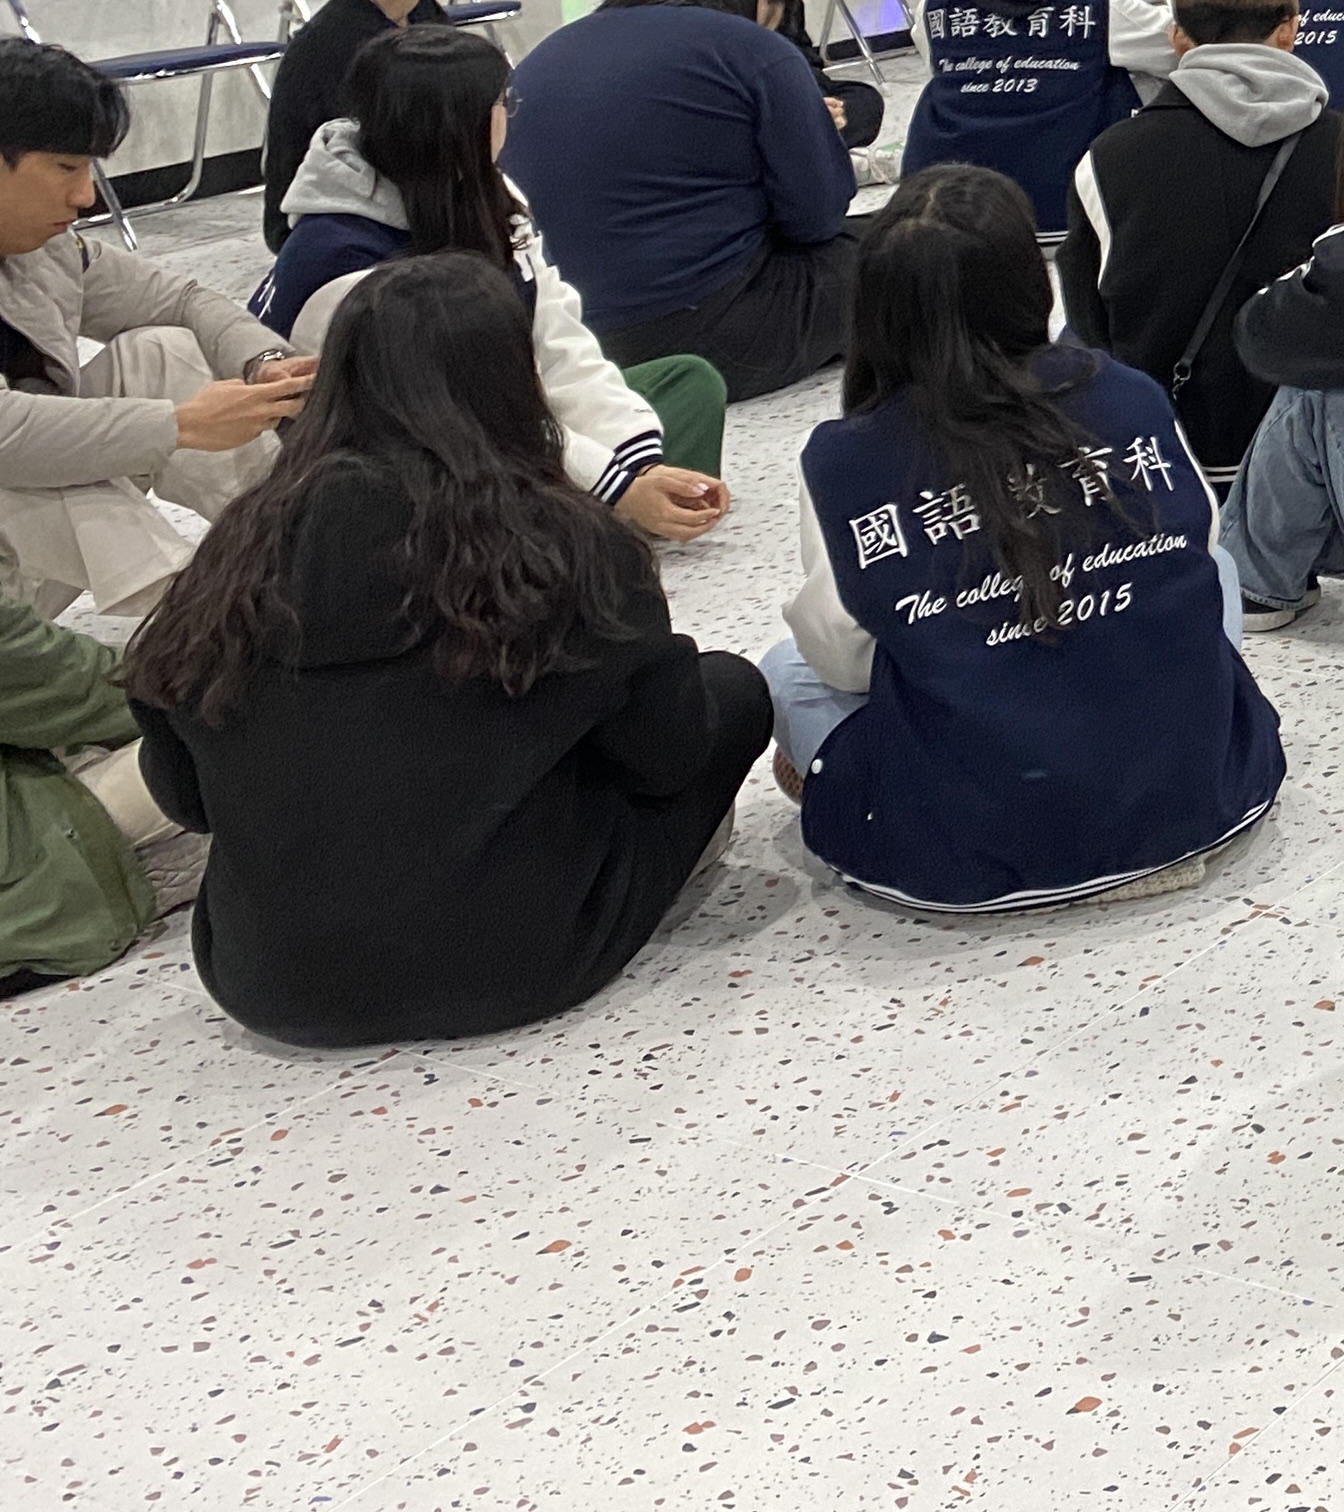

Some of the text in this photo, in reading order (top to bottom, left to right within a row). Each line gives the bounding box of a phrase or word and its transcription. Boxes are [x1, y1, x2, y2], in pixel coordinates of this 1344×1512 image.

[1294, 30, 1338, 45] 2015
[955, 56, 993, 74] college
[995, 55, 1013, 74] of
[1013, 55, 1080, 70] education
[960, 78, 1038, 93] since 2013
[895, 532, 1188, 625] The colleg of education
[1057, 582, 1134, 626] 2015
